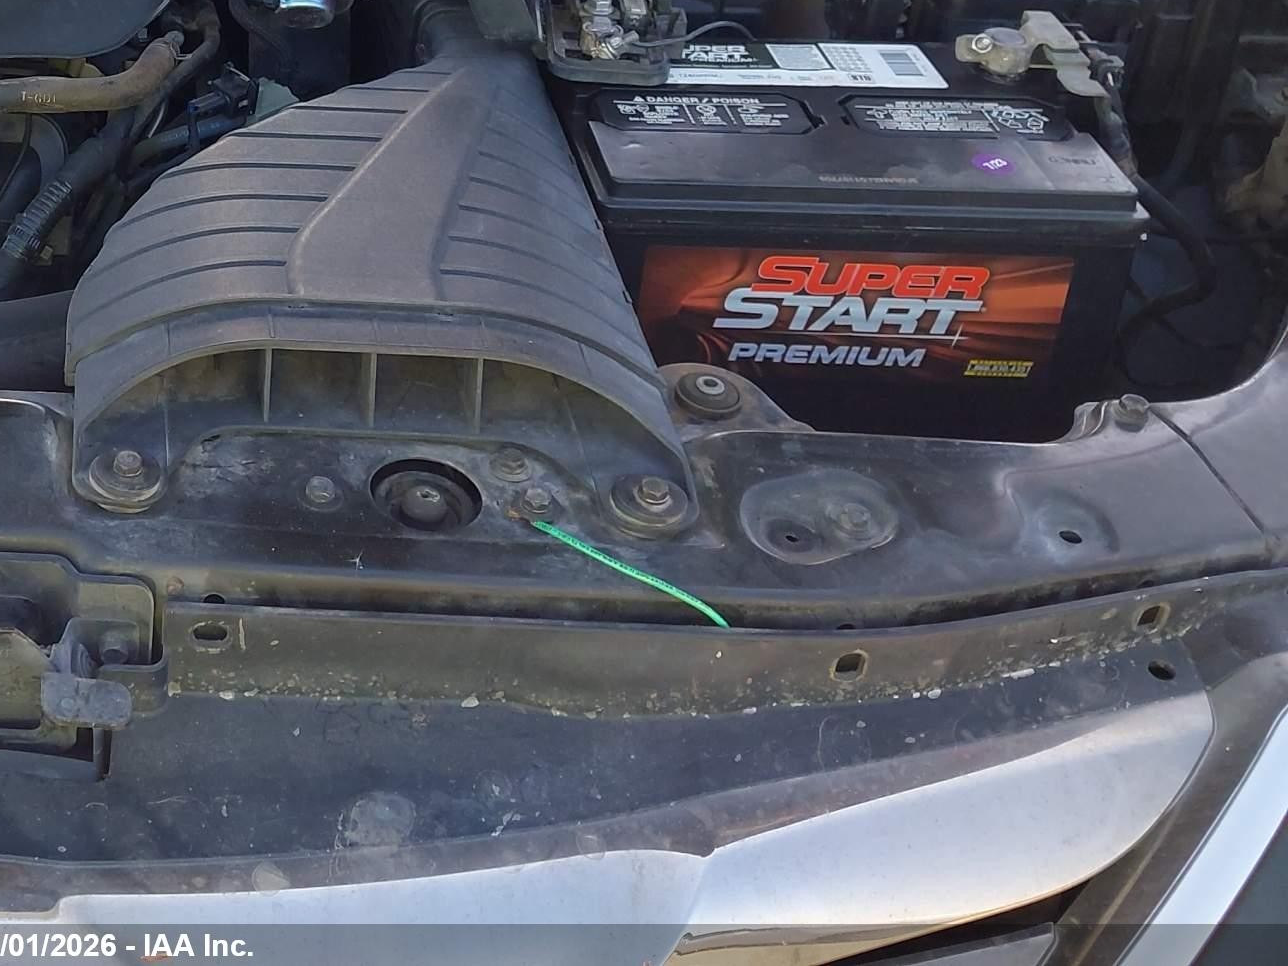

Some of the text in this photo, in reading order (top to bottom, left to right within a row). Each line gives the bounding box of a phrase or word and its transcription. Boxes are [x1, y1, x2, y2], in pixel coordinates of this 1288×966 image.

[646, 96, 700, 104] DANGER
[752, 256, 990, 299] SUPER
[713, 287, 984, 336] START
[727, 342, 926, 368] PREMIUM
